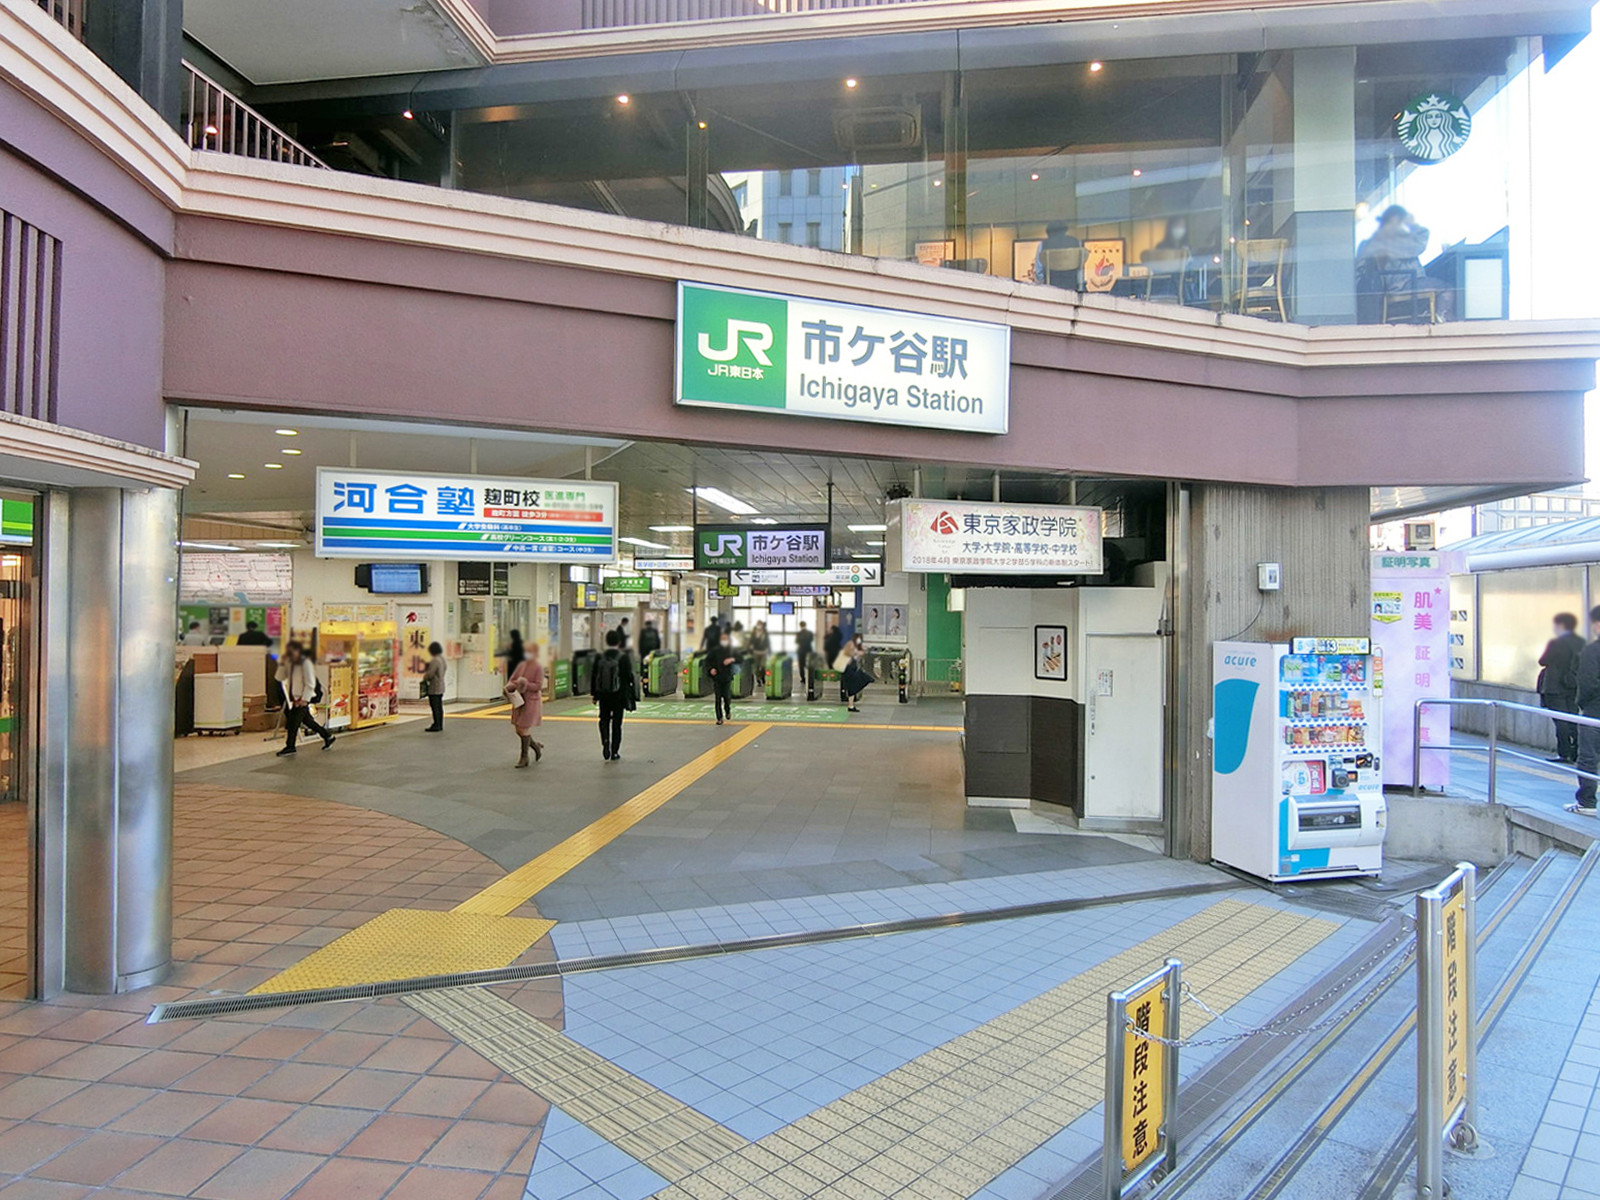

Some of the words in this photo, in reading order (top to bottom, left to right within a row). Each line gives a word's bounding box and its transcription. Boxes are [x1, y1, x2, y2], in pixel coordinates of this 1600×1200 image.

[698, 318, 773, 367] JR
[800, 319, 969, 381] 市ケ谷駅
[707, 363, 764, 380] JR東日本
[799, 373, 899, 411] Ichigaya
[906, 384, 983, 414] Station
[333, 482, 476, 516] 河合塾
[963, 513, 1077, 538] 東京家政学院
[703, 534, 743, 557] JR
[752, 554, 787, 565] Ichigaya
[788, 554, 819, 563] Station
[1382, 556, 1431, 568] 証明写真
[1224, 655, 1257, 667] acure
[1132, 1001, 1151, 1159] 階段注意
